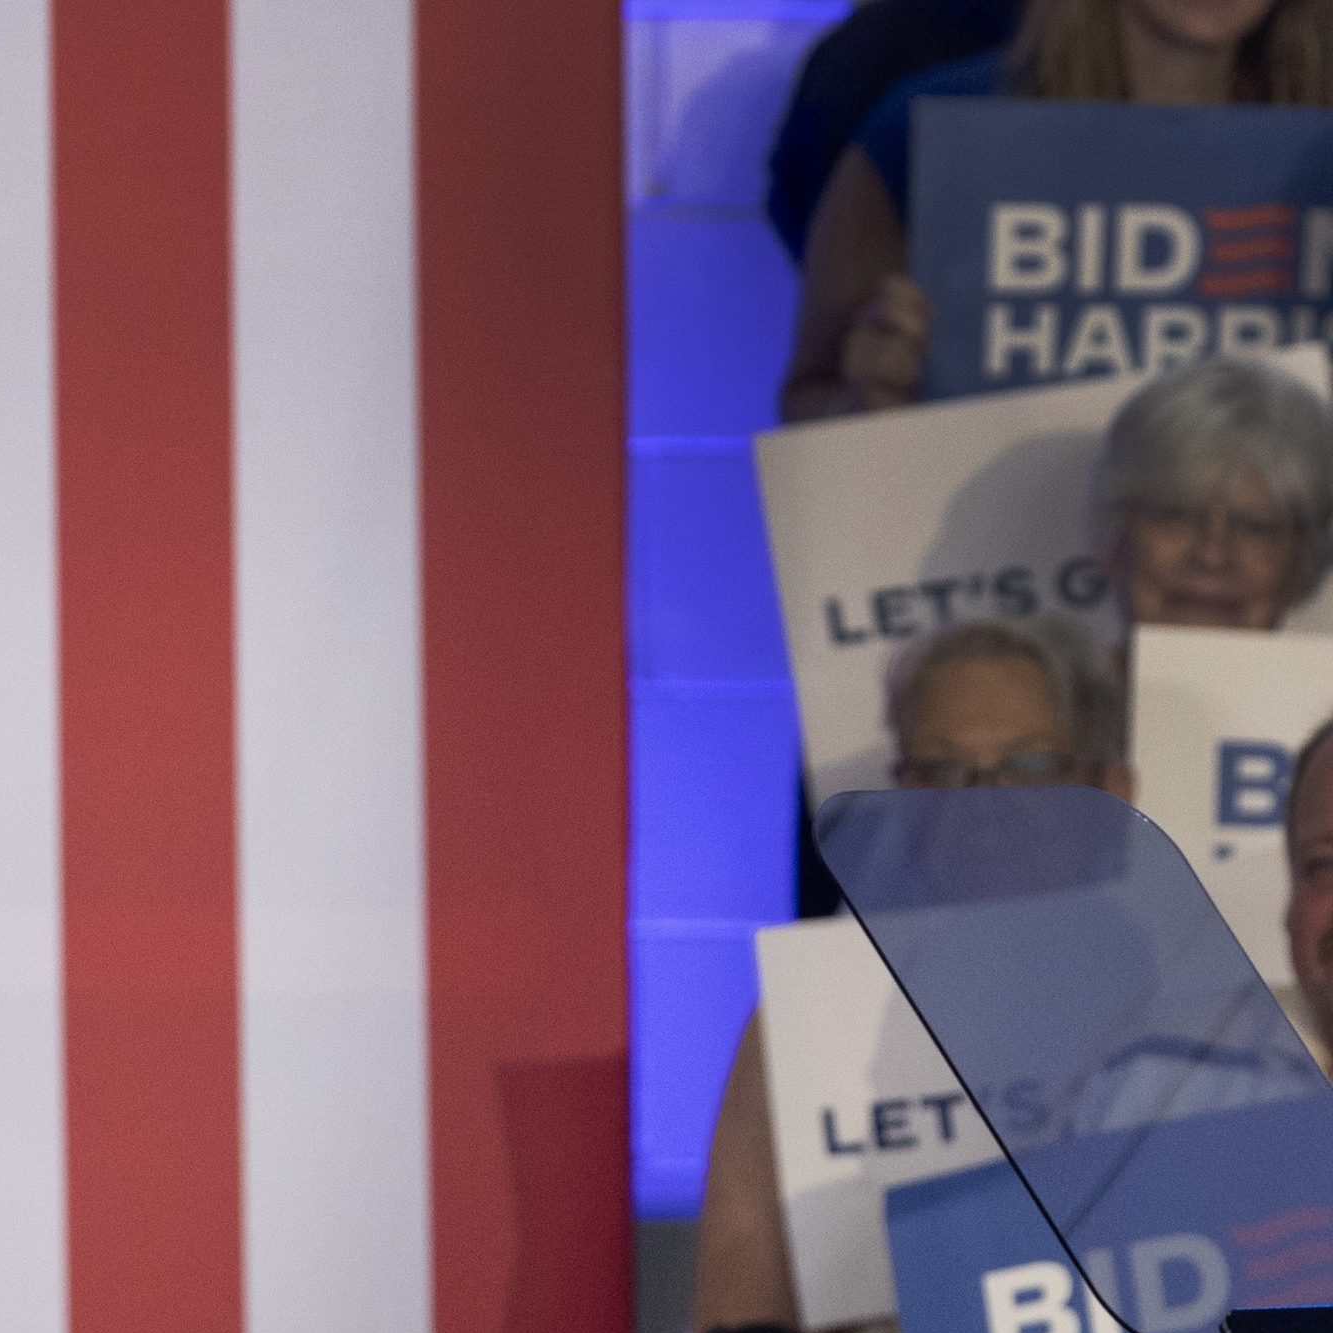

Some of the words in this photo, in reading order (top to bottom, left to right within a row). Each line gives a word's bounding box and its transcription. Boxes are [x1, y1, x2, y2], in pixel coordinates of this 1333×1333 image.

[824, 565, 1040, 648] LET'S
[1057, 556, 1110, 609] G
[1214, 738, 1297, 830] B
